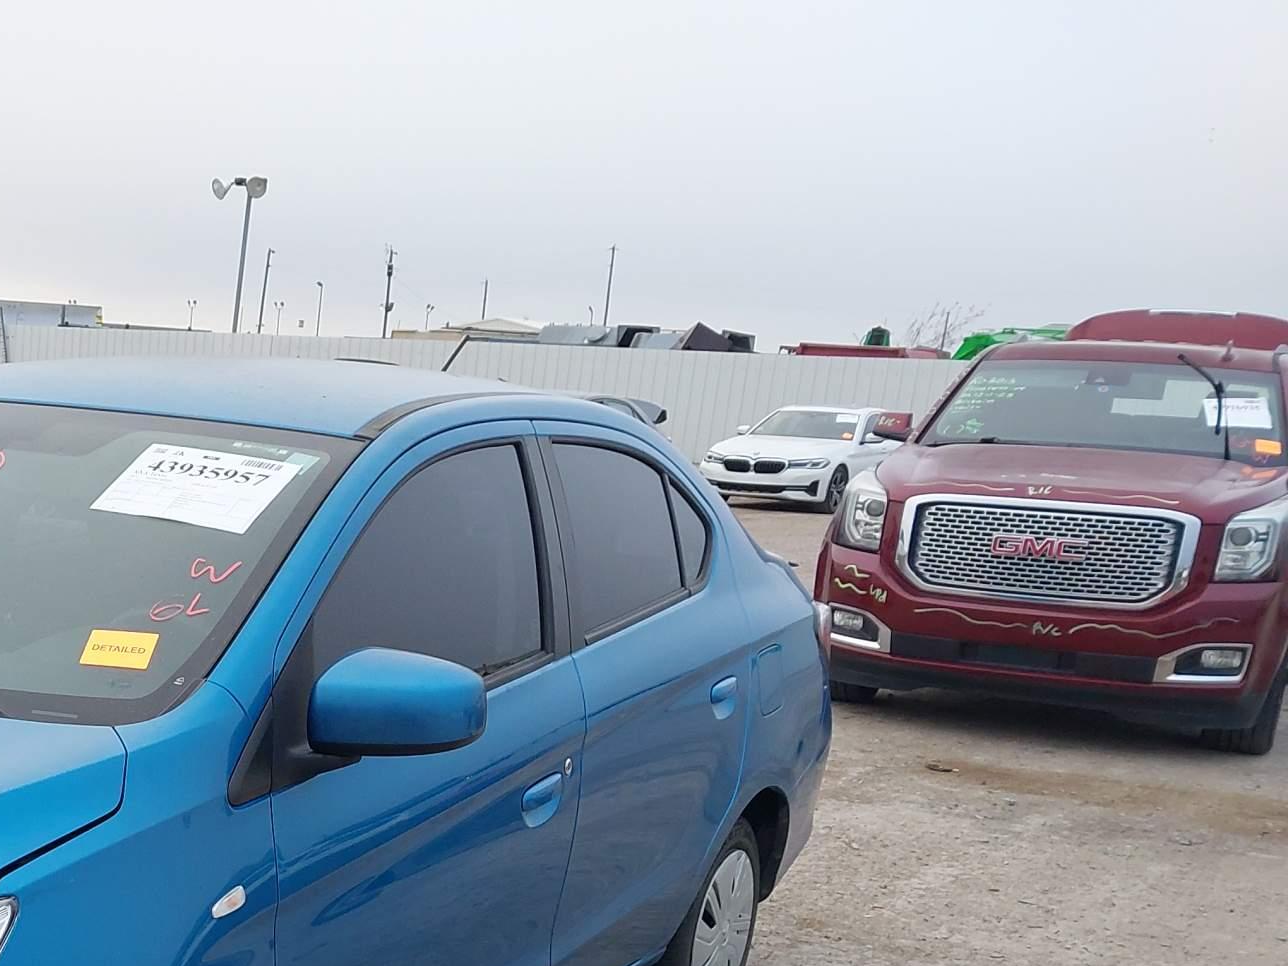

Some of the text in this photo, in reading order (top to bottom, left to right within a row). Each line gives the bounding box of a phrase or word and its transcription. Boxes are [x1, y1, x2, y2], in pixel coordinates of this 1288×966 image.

[147, 458, 273, 487] 43935957
[991, 535, 1088, 560] GMC
[91, 642, 146, 655] DETAILED
